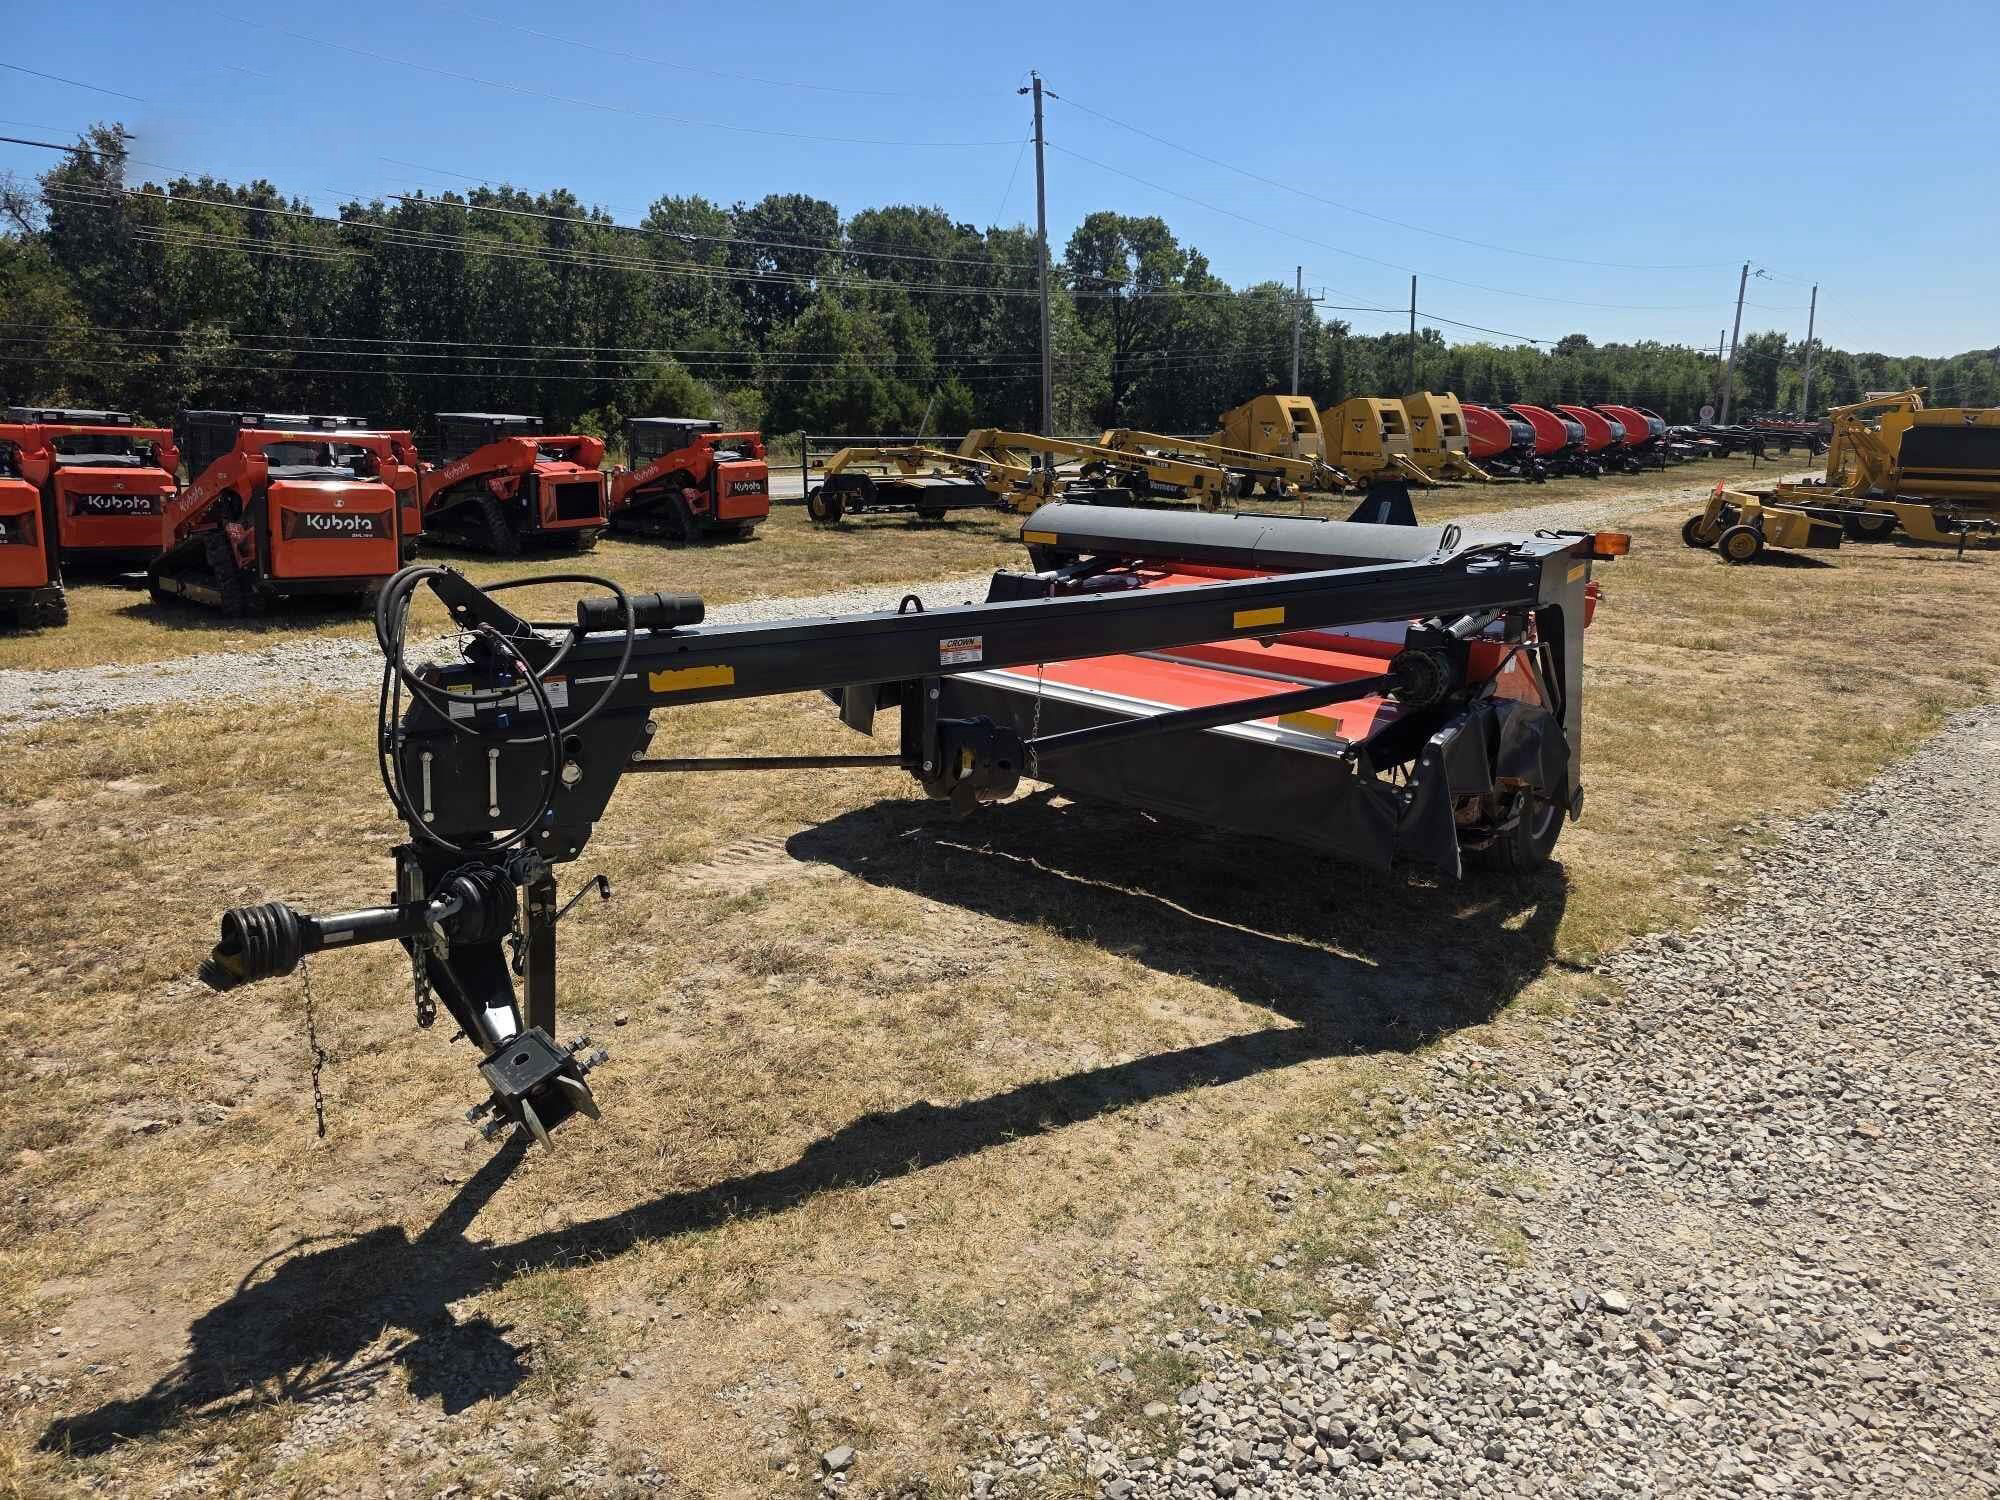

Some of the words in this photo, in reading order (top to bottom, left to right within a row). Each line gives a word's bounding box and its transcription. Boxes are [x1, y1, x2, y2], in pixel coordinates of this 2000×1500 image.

[734, 482, 761, 492] Kubota
[88, 495, 151, 509] Kubota
[306, 514, 373, 530] Kubota
[946, 637, 975, 648] CROWN
